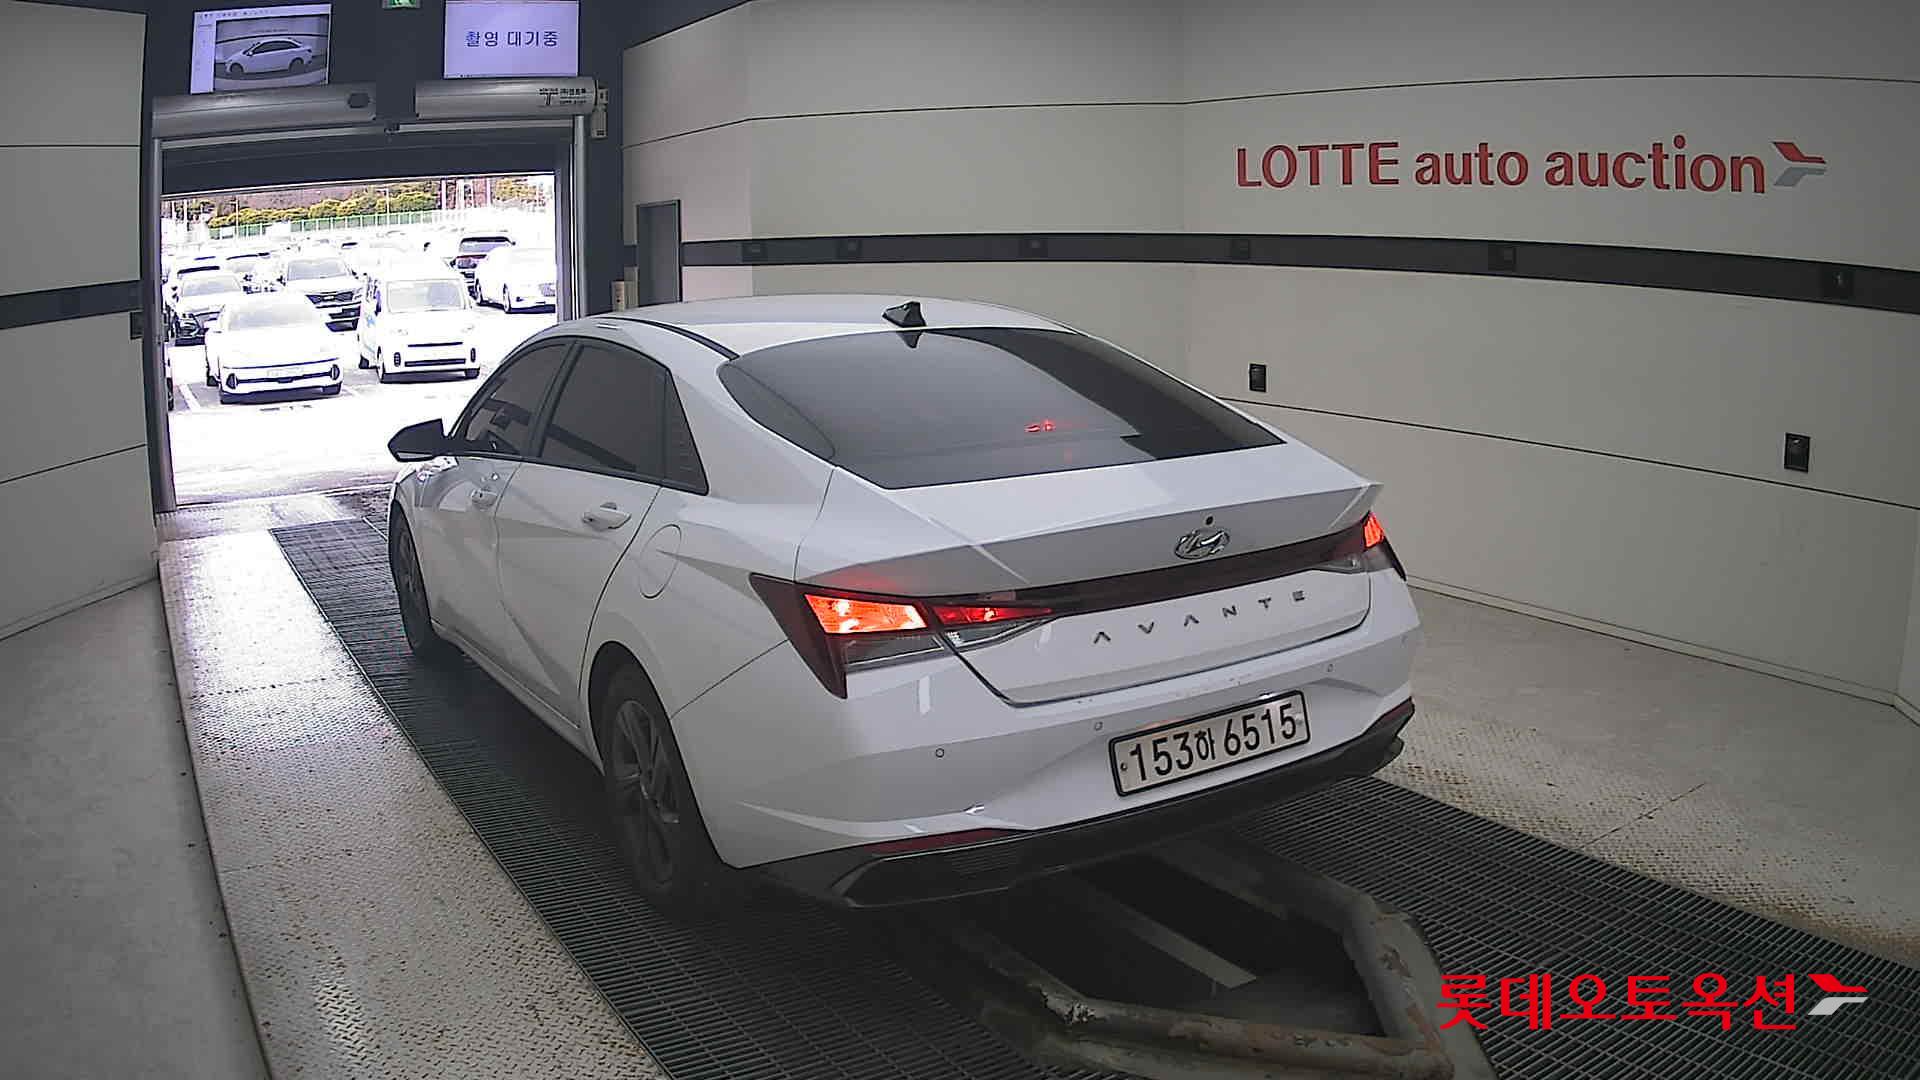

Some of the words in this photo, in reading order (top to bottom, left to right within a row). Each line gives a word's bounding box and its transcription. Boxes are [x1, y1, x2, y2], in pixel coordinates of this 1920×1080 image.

[464, 31, 498, 47] 촬영
[507, 31, 558, 47] 대기중
[1237, 143, 1399, 188] LOTTE
[1415, 143, 1528, 186] auto
[1545, 135, 1766, 194] auction
[1094, 591, 1305, 644] AVANTE
[1130, 727, 1215, 781] 153하
[1223, 703, 1296, 756] 6515
